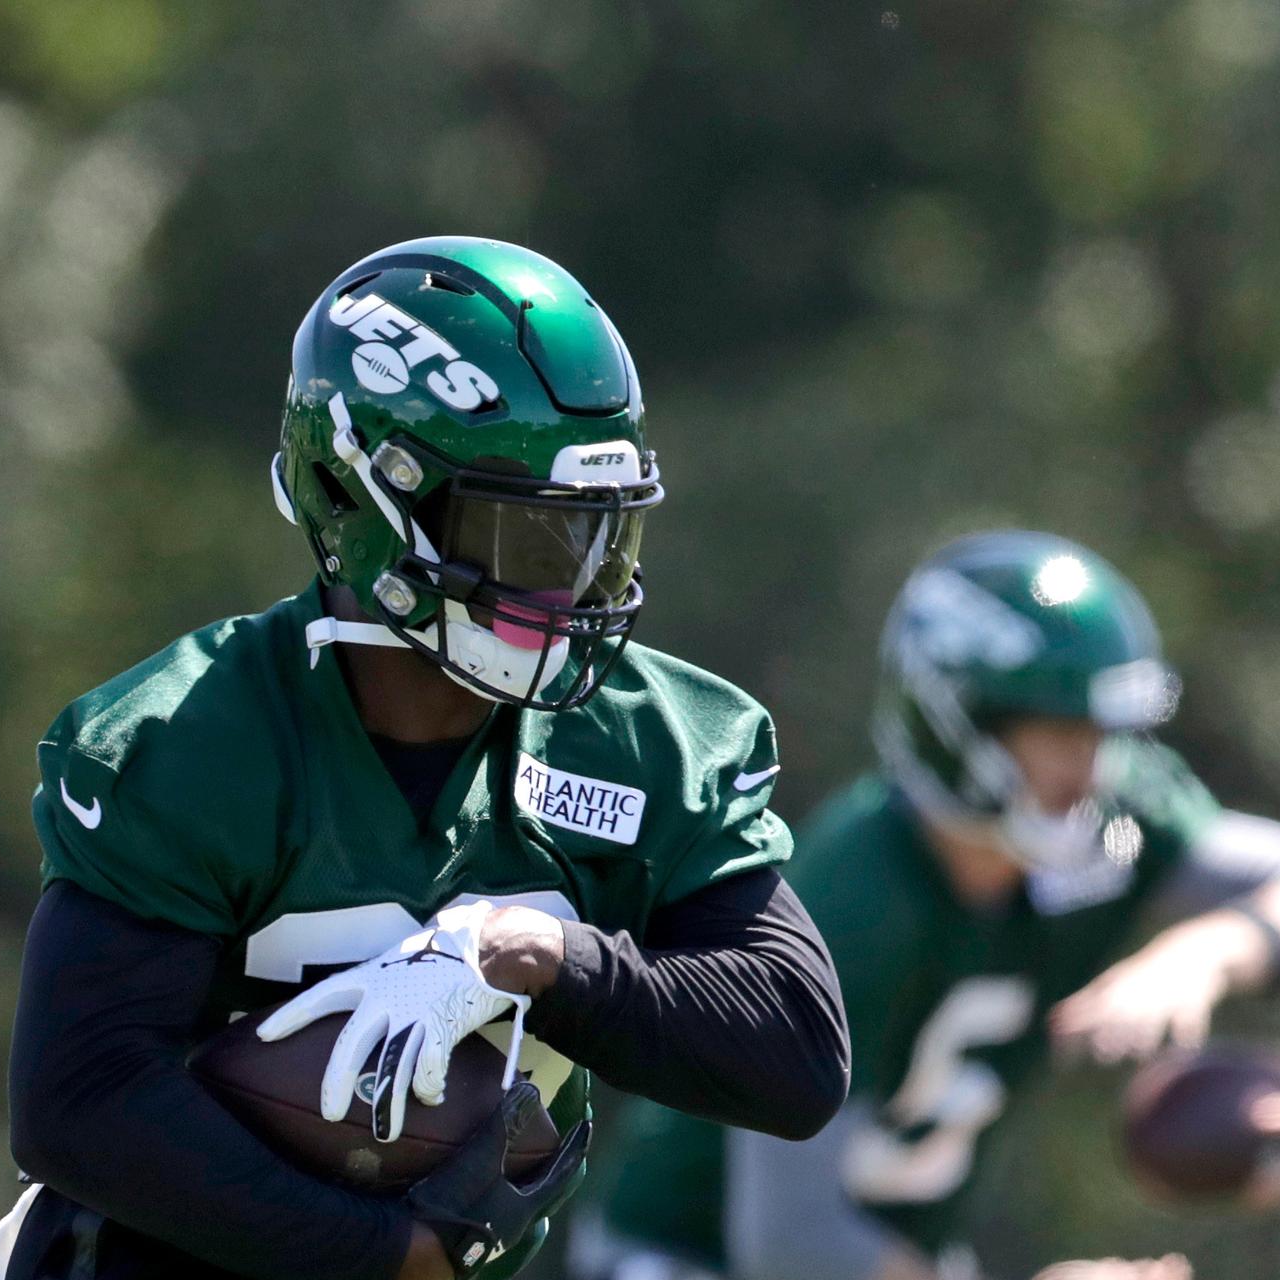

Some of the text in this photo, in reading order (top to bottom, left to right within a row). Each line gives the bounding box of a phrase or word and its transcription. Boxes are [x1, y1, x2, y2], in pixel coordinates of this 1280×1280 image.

[329, 291, 500, 412] JETS
[580, 452, 626, 466] JETS
[520, 765, 638, 816] ATLANTIC
[528, 787, 619, 834] HEALTH
[839, 974, 1035, 1202] 5
